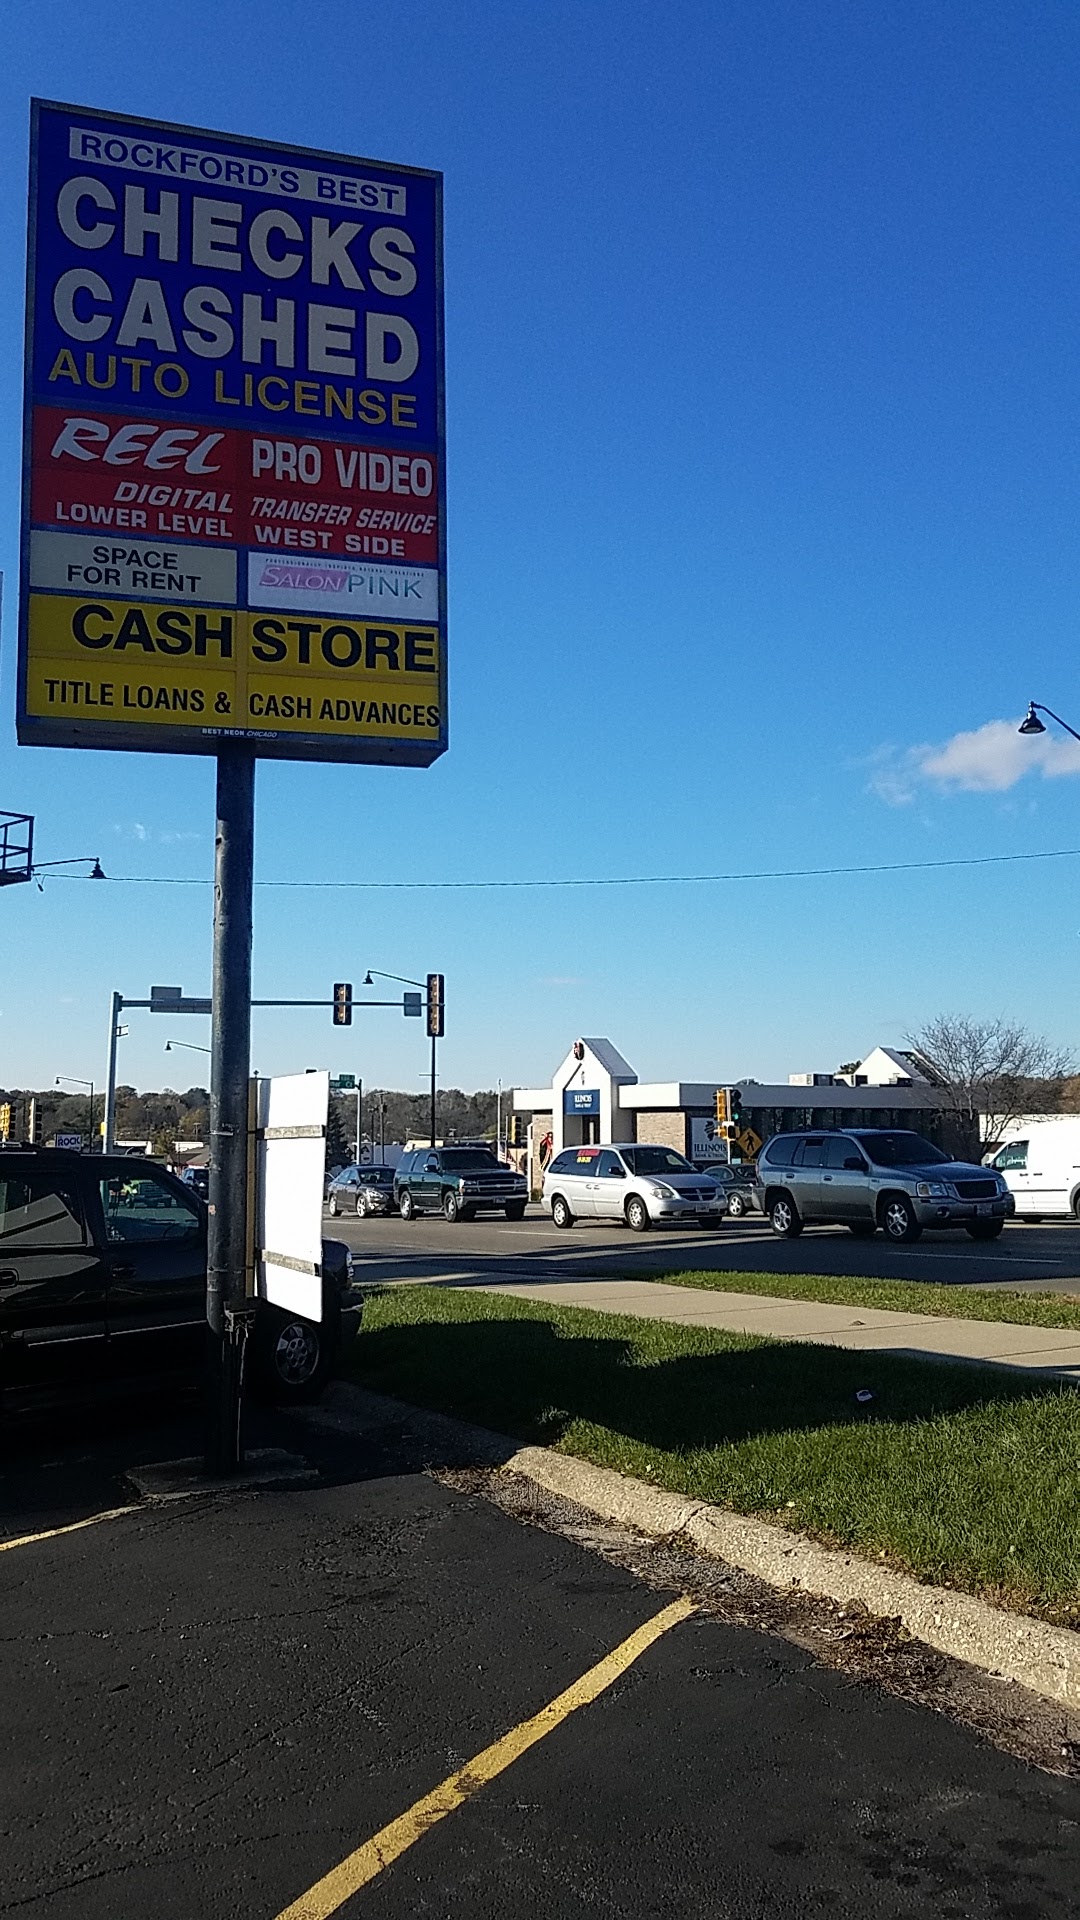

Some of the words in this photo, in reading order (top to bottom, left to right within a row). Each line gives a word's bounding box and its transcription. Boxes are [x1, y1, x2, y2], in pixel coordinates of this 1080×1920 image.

[80, 133, 299, 194] ROCKFORD'S
[317, 177, 400, 210] BEST
[57, 176, 418, 297] CHECKS
[53, 268, 420, 382] CASHED
[48, 349, 190, 398] AUTO
[214, 370, 418, 429] LICENSE
[50, 417, 226, 475] REEL
[252, 438, 322, 485] PRO
[335, 448, 433, 497] VIDEO
[56, 501, 147, 529] LOWER
[158, 512, 233, 538] LEVEL
[254, 525, 333, 550] WEST
[345, 534, 405, 557] SIDE
[113, 481, 234, 514] DIGITAL
[249, 496, 351, 527] TRANSFER
[355, 507, 437, 535] SERVICE
[67, 565, 121, 588] FOR
[132, 571, 201, 593] RENT
[92, 545, 179, 571] SPACE
[261, 566, 342, 591] SALON
[347, 574, 423, 599] PINK
[71, 604, 233, 658] CASH
[251, 619, 437, 673] STORE
[44, 679, 114, 707] TITLE
[123, 684, 205, 712] LOANS
[213, 692, 232, 714] &
[249, 693, 312, 720] CASH
[318, 699, 441, 727] ADVANCES
[202, 727, 222, 735] BEST
[246, 730, 277, 738] CHICAGO
[694, 1143, 727, 1152] ILLINOIS
